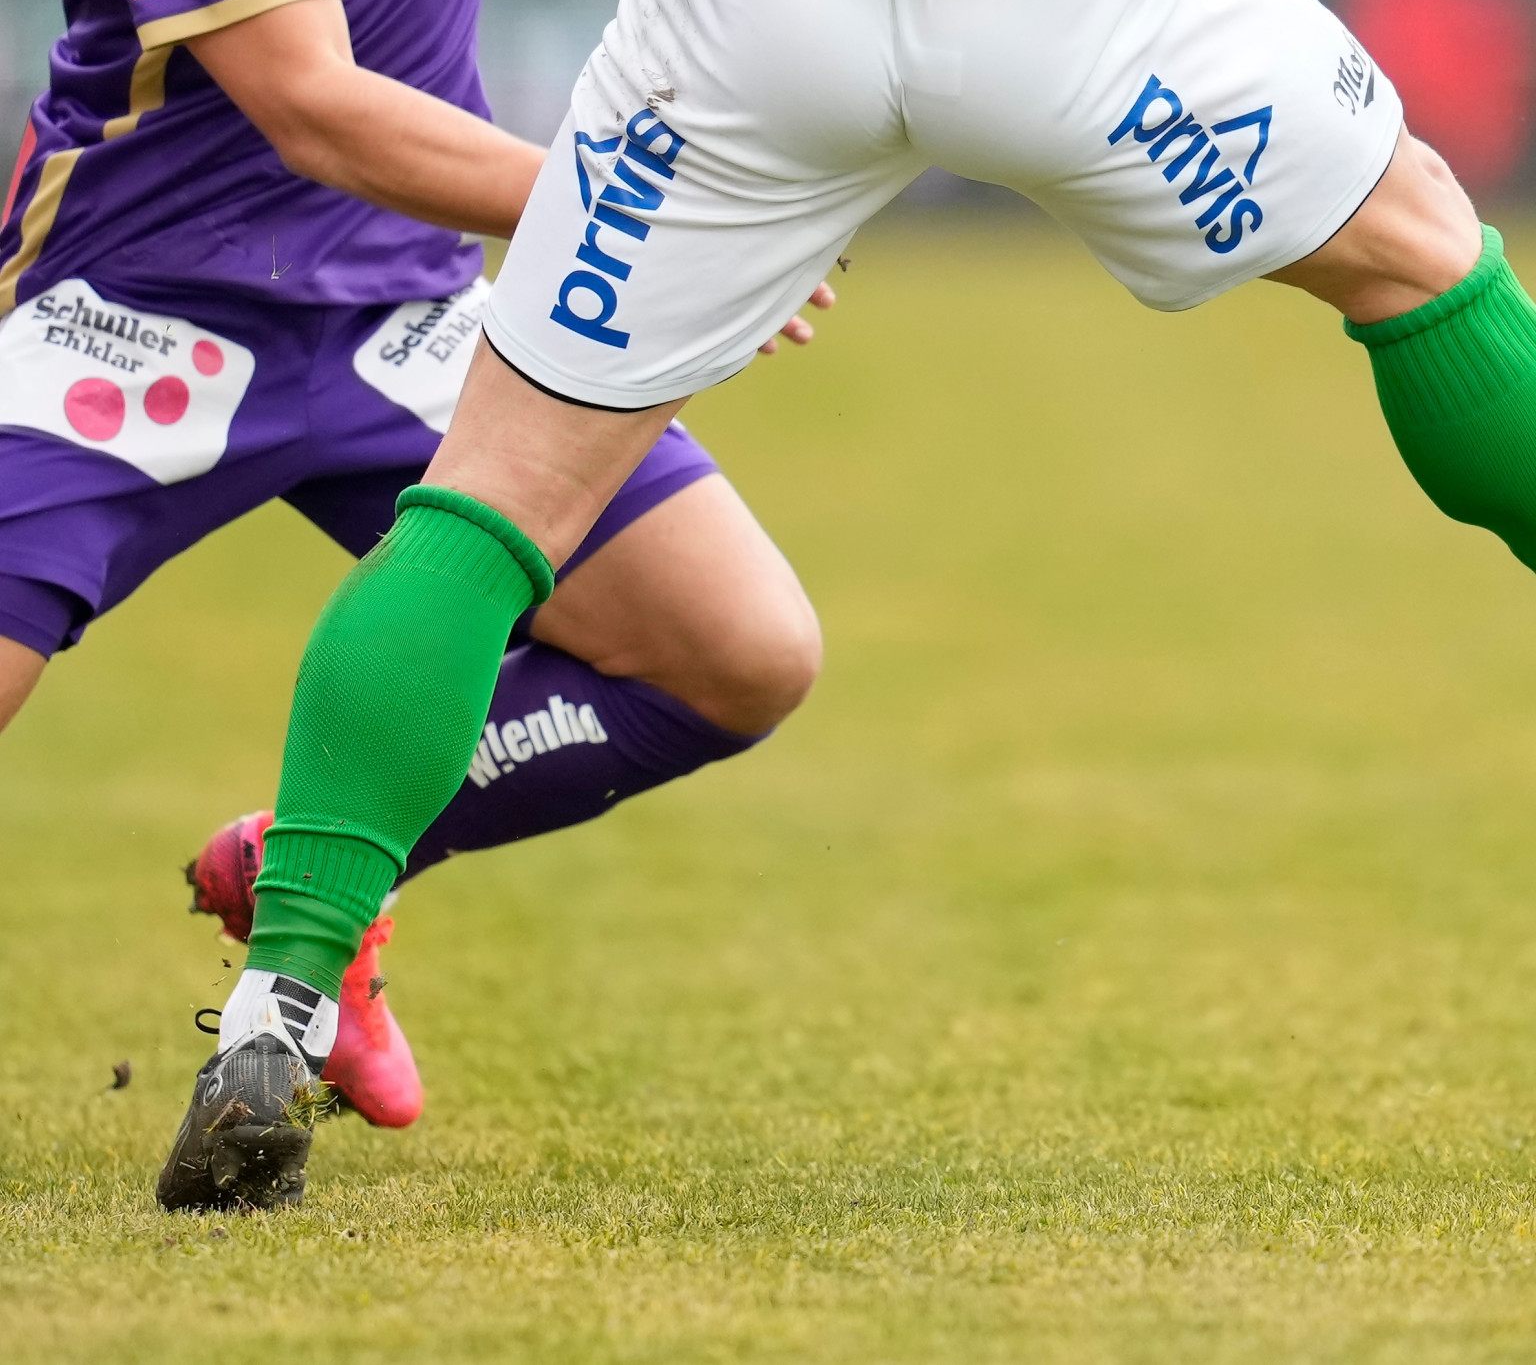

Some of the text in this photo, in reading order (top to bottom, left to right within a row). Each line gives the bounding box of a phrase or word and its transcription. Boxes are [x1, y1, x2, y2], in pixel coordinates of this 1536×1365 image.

[549, 107, 687, 350] privis
[1107, 74, 1264, 255] privis
[31, 294, 178, 357] Schuller
